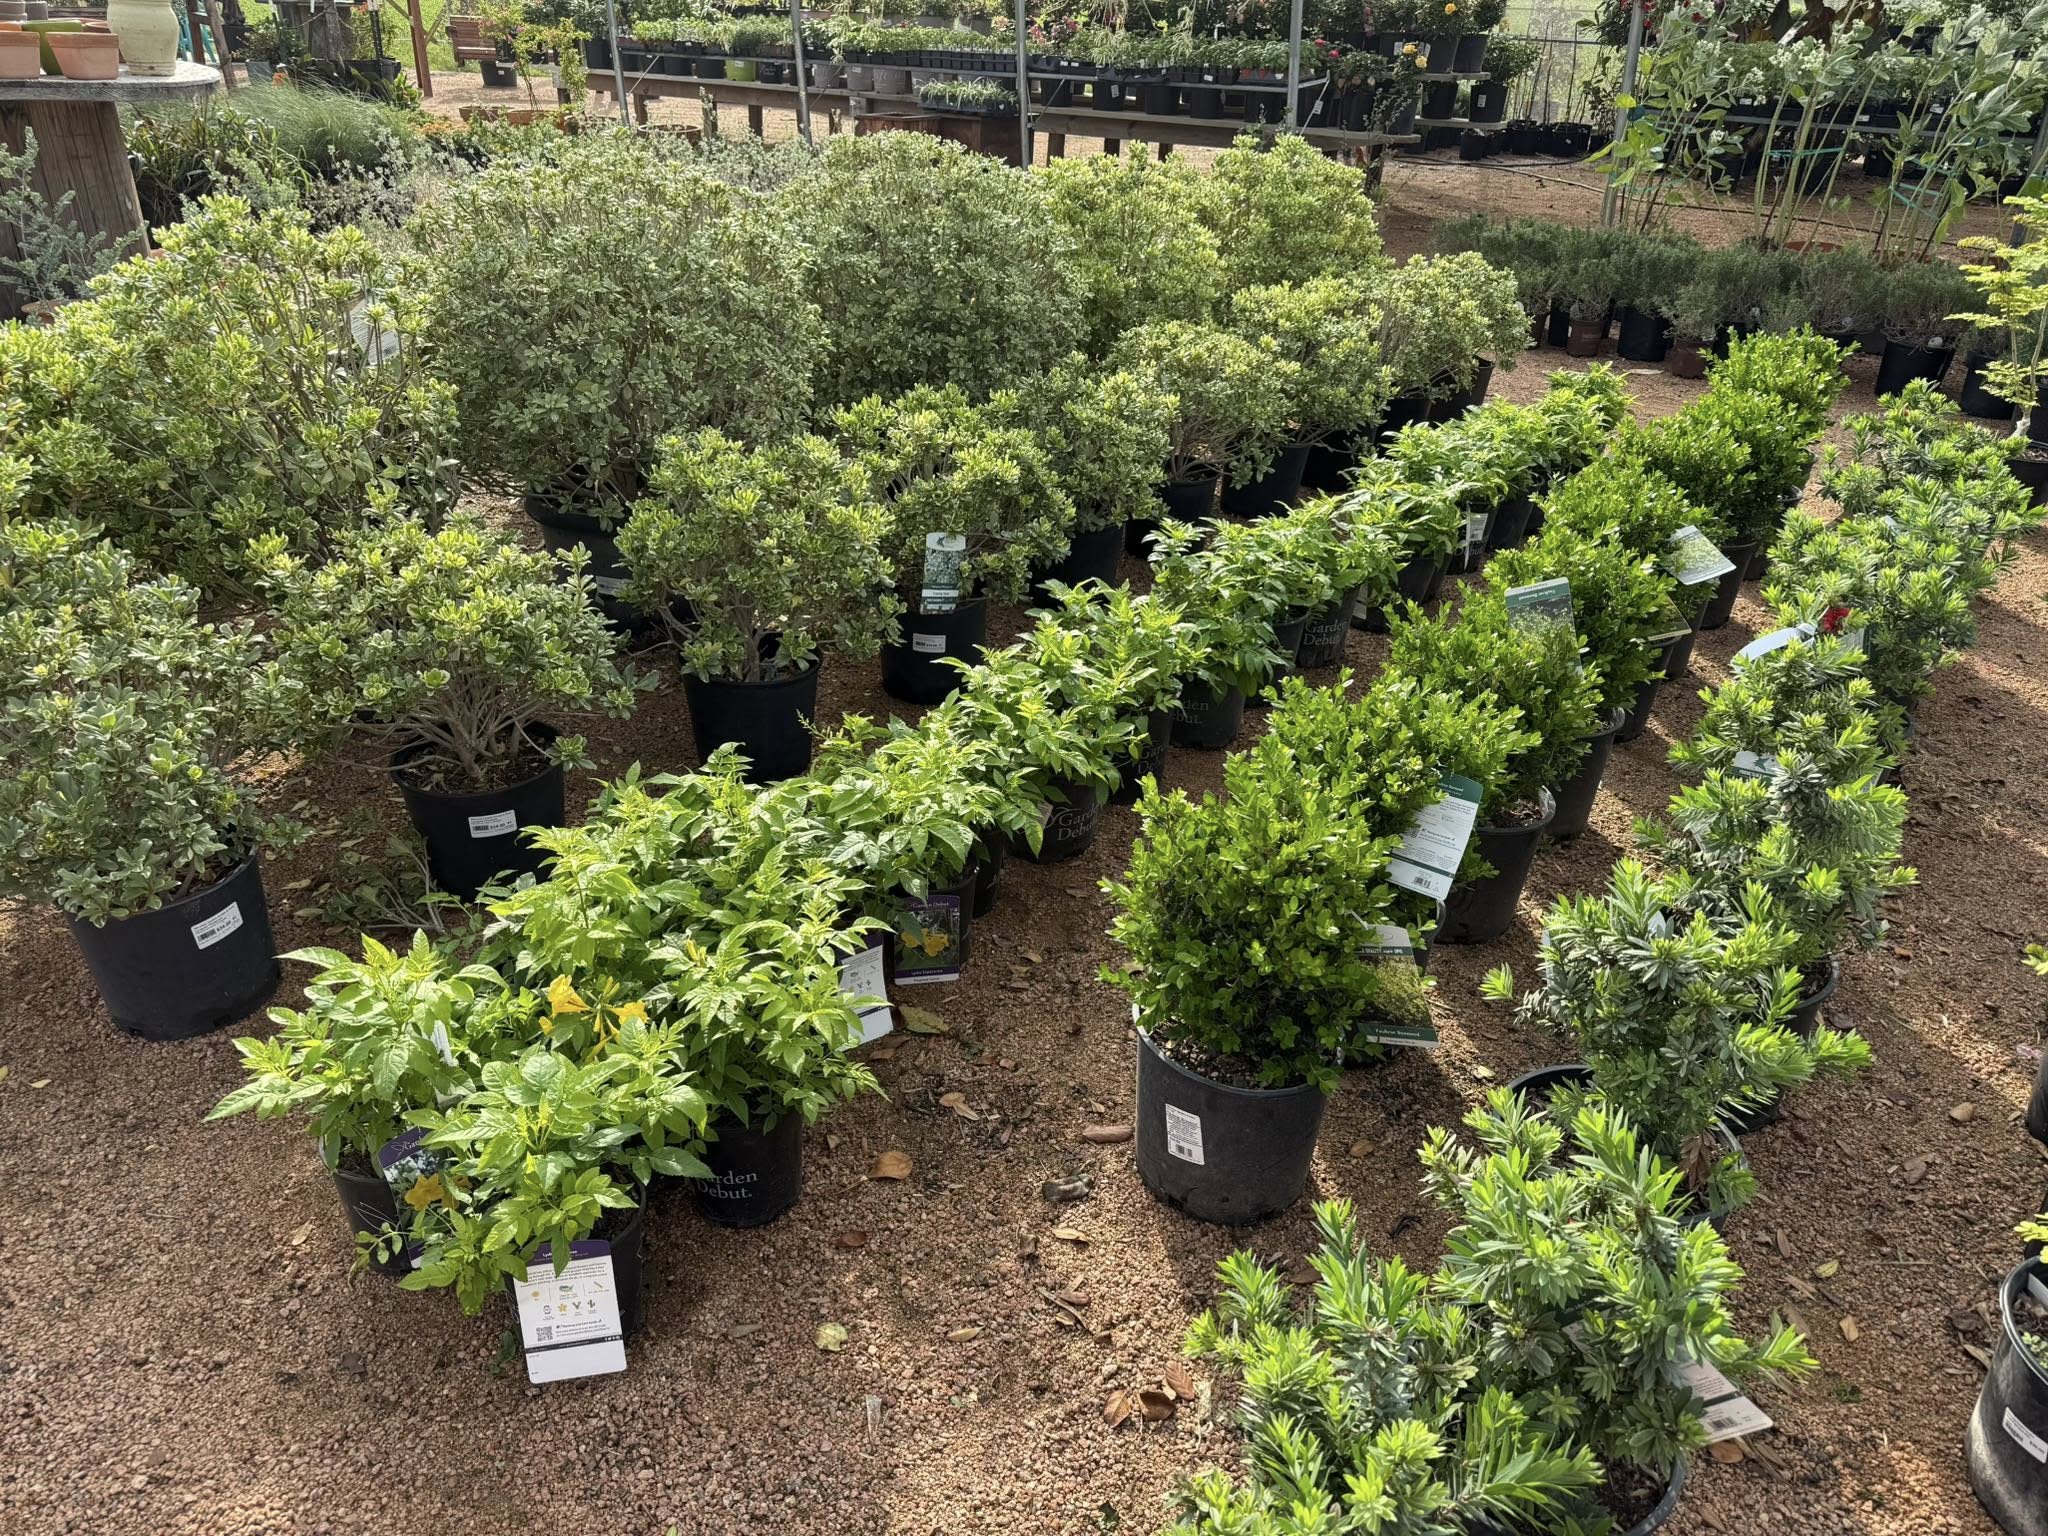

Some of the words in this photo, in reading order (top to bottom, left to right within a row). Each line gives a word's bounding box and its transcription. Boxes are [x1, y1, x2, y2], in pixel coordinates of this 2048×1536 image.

[1059, 802, 1095, 827] Gard
[1056, 822, 1093, 841] Debu
[709, 1170, 760, 1185] rden
